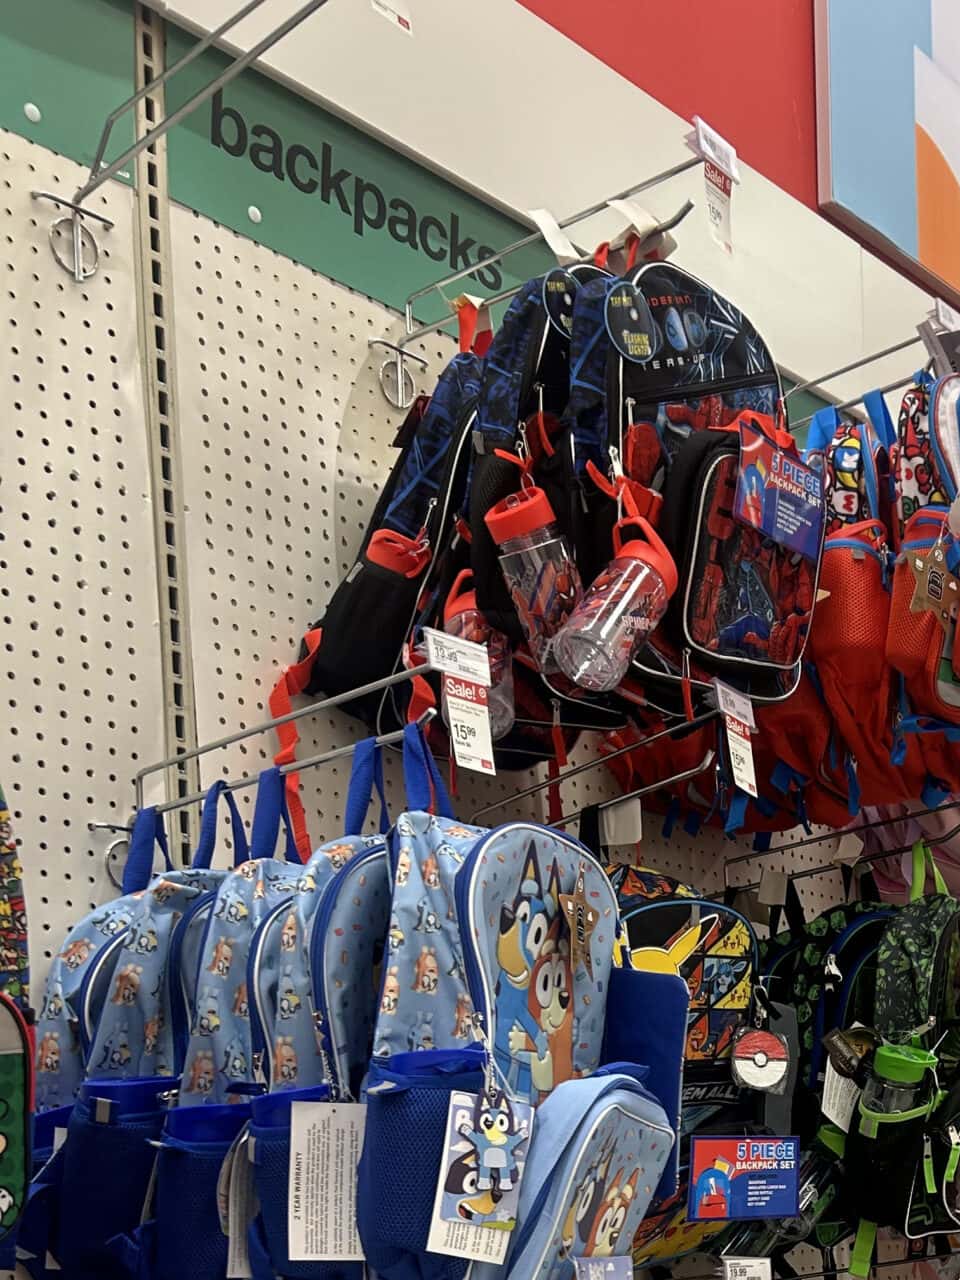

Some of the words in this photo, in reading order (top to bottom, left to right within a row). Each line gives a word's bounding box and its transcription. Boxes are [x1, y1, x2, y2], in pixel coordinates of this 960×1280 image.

[210, 88, 503, 291] backpacks
[769, 471, 807, 501] BACKPACK
[807, 494, 822, 508] SET
[771, 452, 781, 473] 5
[783, 459, 821, 499] PIECE
[446, 677, 477, 701] Sale!
[736, 1142, 747, 1160] 5
[750, 1142, 794, 1160] PIECE
[736, 1160, 778, 1170] BACKPACK
[780, 1160, 796, 1169] SET
[294, 1152, 303, 1188] WARRANTY
[730, 1268, 747, 1278] 19.99
